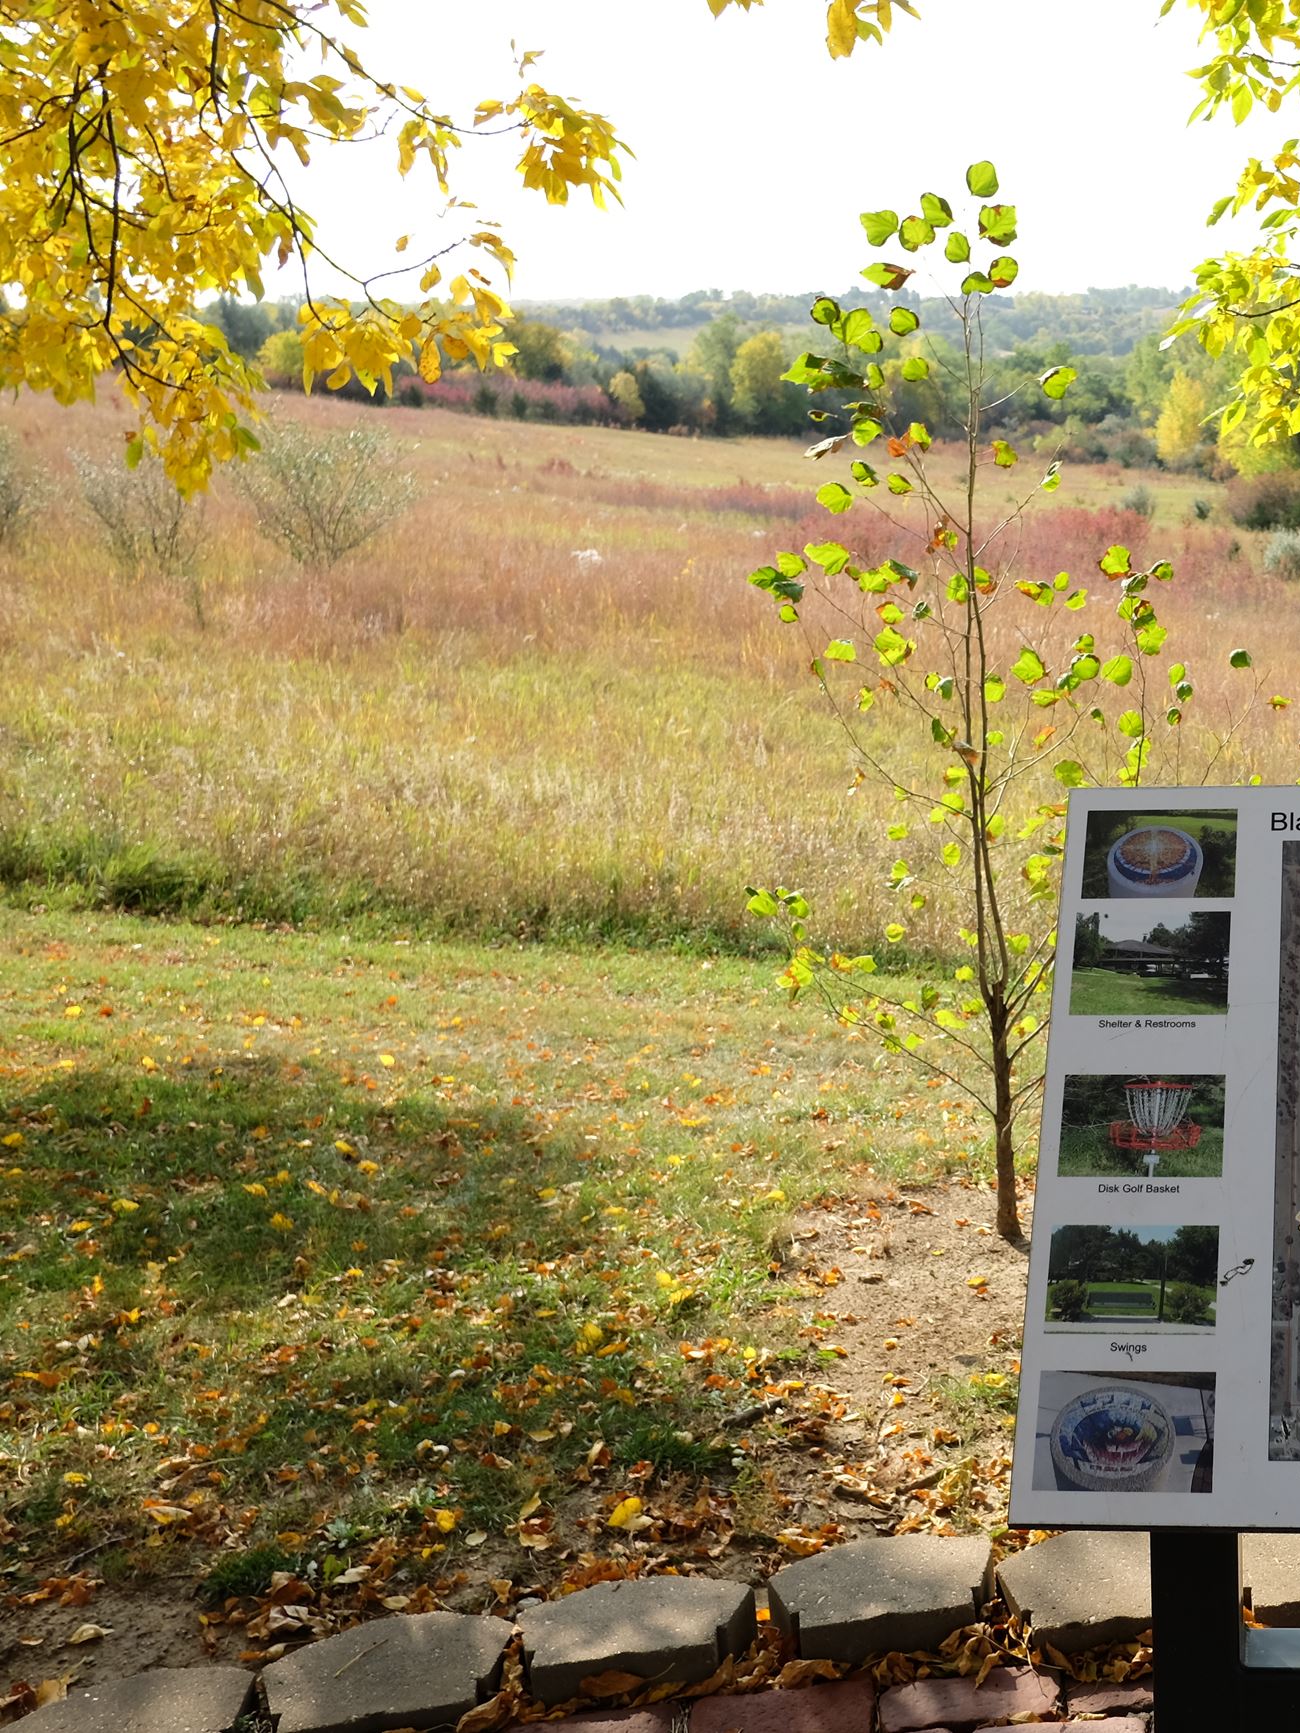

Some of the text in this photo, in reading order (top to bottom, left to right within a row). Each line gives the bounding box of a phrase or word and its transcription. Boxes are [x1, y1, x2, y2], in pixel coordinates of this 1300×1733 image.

[1099, 1019, 1196, 1029] Shelter & Restrooms
[1099, 1184, 1179, 1194] Disk Golf Basket
[1110, 1342, 1147, 1354] Swings
